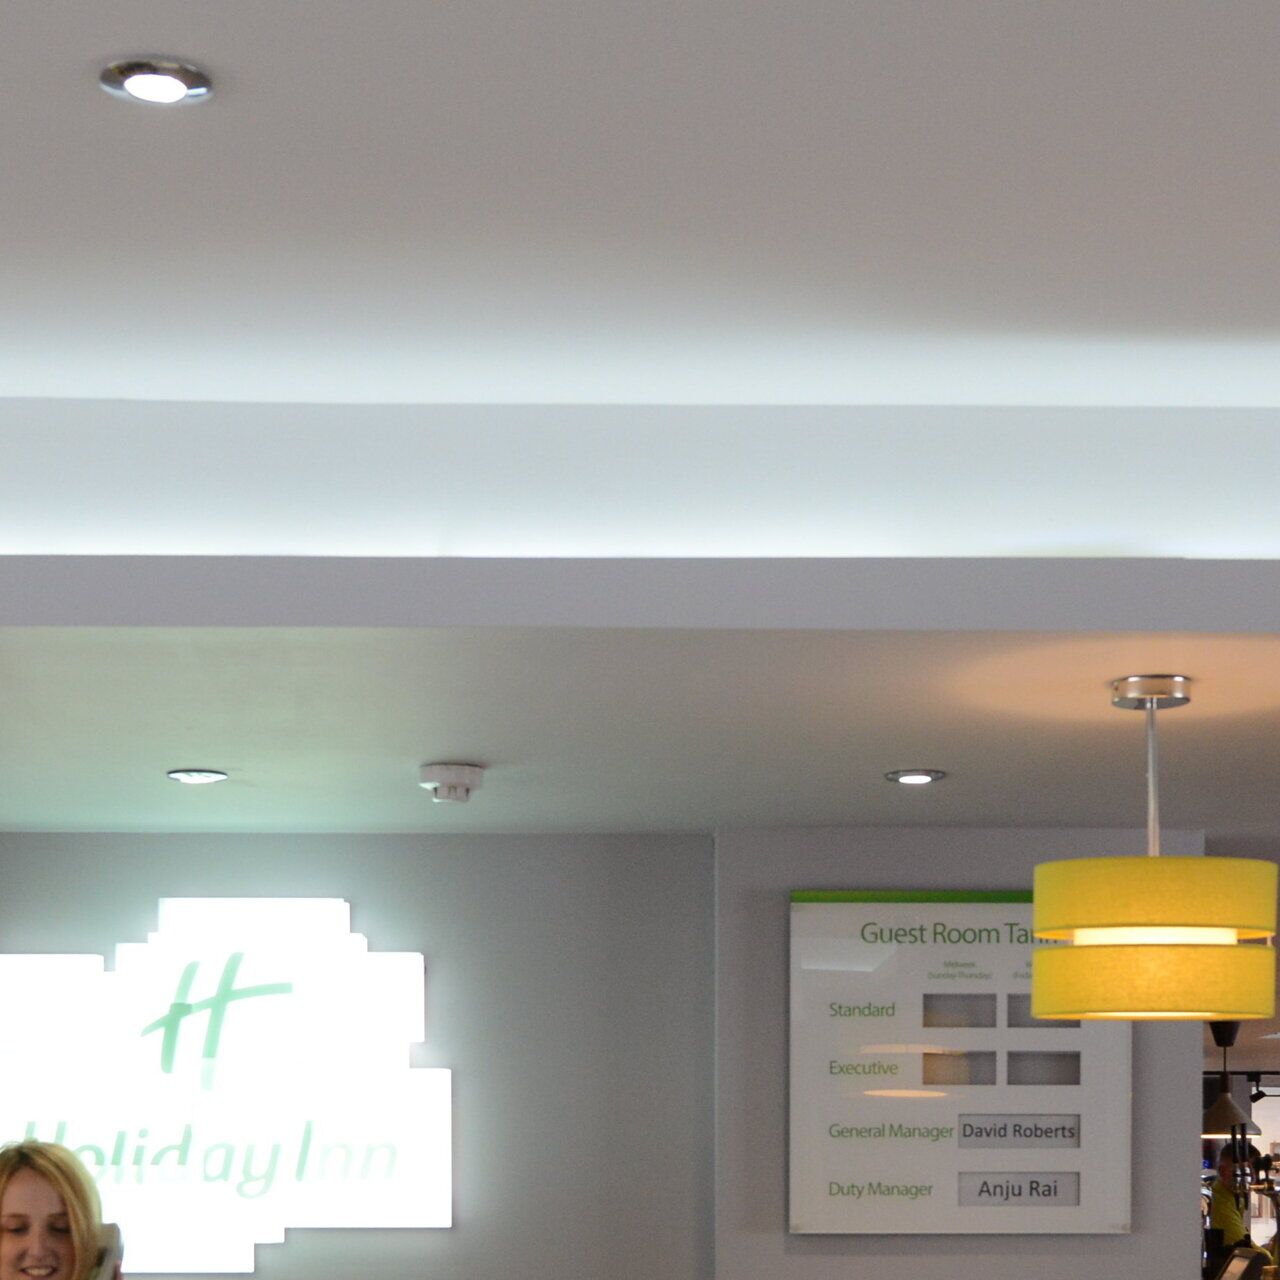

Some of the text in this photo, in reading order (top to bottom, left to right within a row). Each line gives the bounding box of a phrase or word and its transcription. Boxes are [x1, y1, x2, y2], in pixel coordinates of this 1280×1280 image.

[861, 922, 927, 944] Guest
[933, 922, 1000, 944] Room
[829, 1001, 896, 1018] Standard
[829, 1060, 899, 1075] Executive
[829, 1123, 955, 1143] General Manager
[962, 1123, 1076, 1139] David Roberts
[295, 1120, 398, 1183] Inn
[828, 1181, 934, 1201] Duty Manager
[978, 1180, 1058, 1201] Anju Rai
